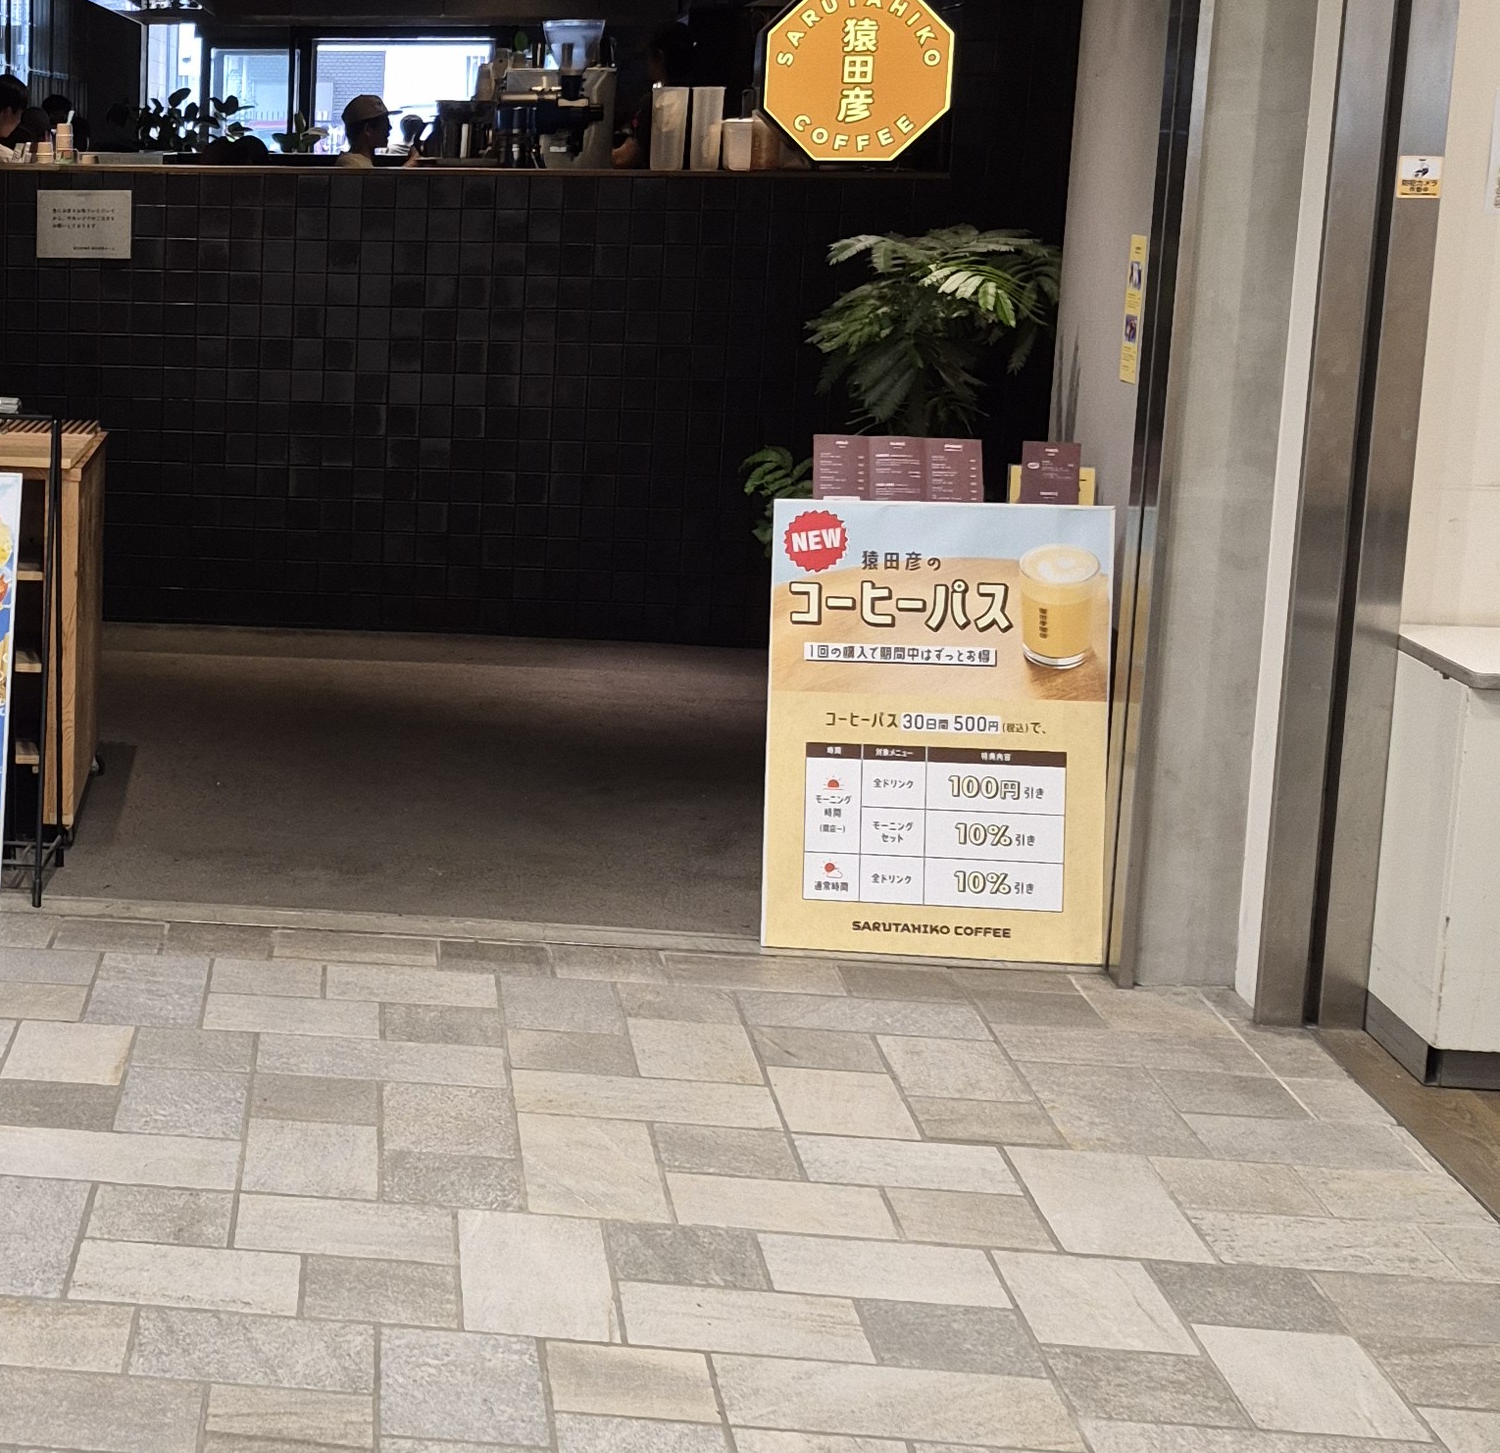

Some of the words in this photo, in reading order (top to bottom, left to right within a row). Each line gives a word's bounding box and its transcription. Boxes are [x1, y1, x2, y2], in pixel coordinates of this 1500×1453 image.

[836, 17, 879, 123] 猿田彦
[793, 114, 916, 152] COFFEE
[791, 527, 841, 553] NEW
[862, 550, 941, 571] 猿田彦の
[789, 579, 1014, 633] コーヒーパス
[825, 712, 898, 728] コーヒーパス
[873, 778, 914, 789] 全ドリンク
[815, 794, 852, 805] モーニング
[872, 821, 913, 831] モーニング
[881, 833, 903, 843] セット
[871, 874, 912, 884] 全ドリンク
[852, 920, 951, 935] SARUTAHIKO
[954, 925, 1011, 938] COFFEE
